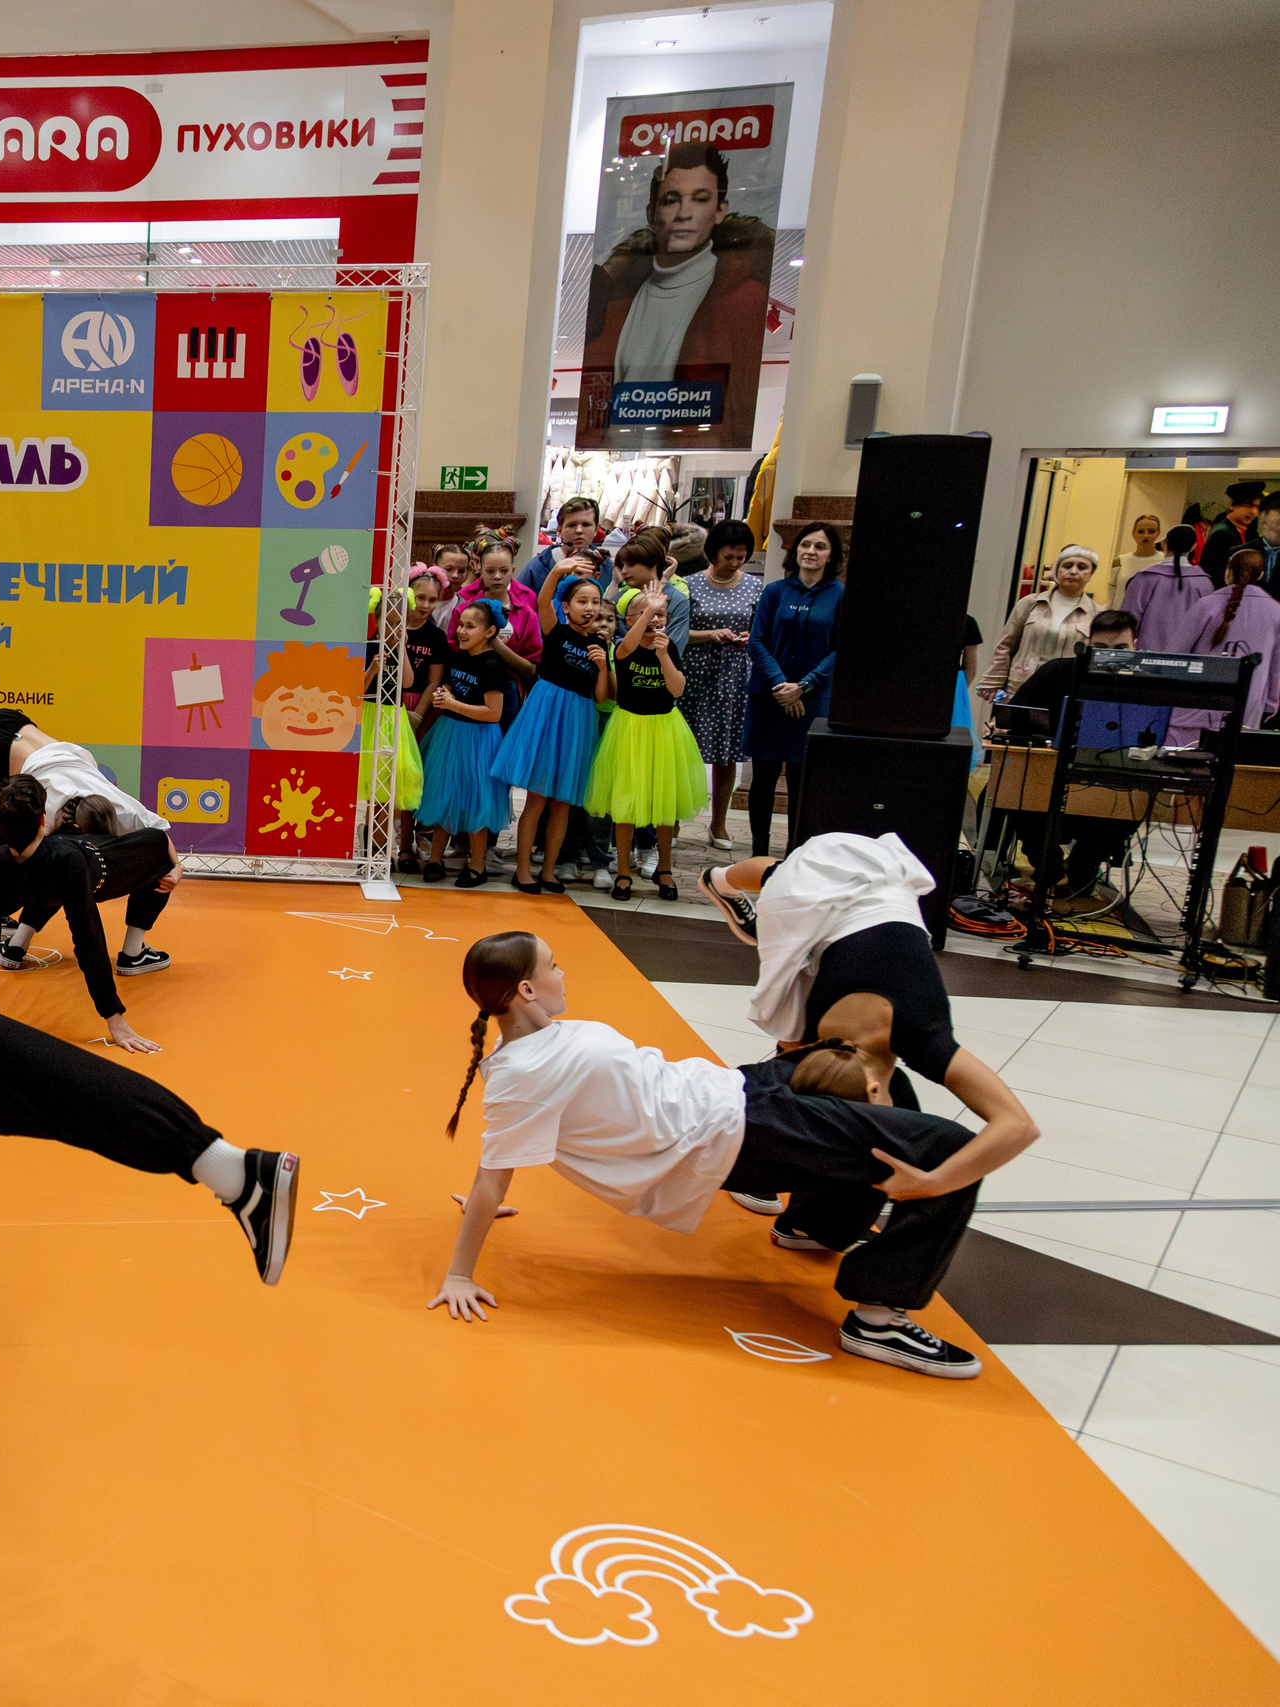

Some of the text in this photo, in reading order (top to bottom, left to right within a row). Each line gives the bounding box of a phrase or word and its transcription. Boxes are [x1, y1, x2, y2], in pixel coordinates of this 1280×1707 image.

[176, 117, 377, 153] ПУХОВИКИ
[619, 387, 712, 405] #Одобрил
[618, 405, 712, 421] Кологривый
[562, 640, 588, 658] BEAUT
[628, 661, 665, 676] BEAUTI
